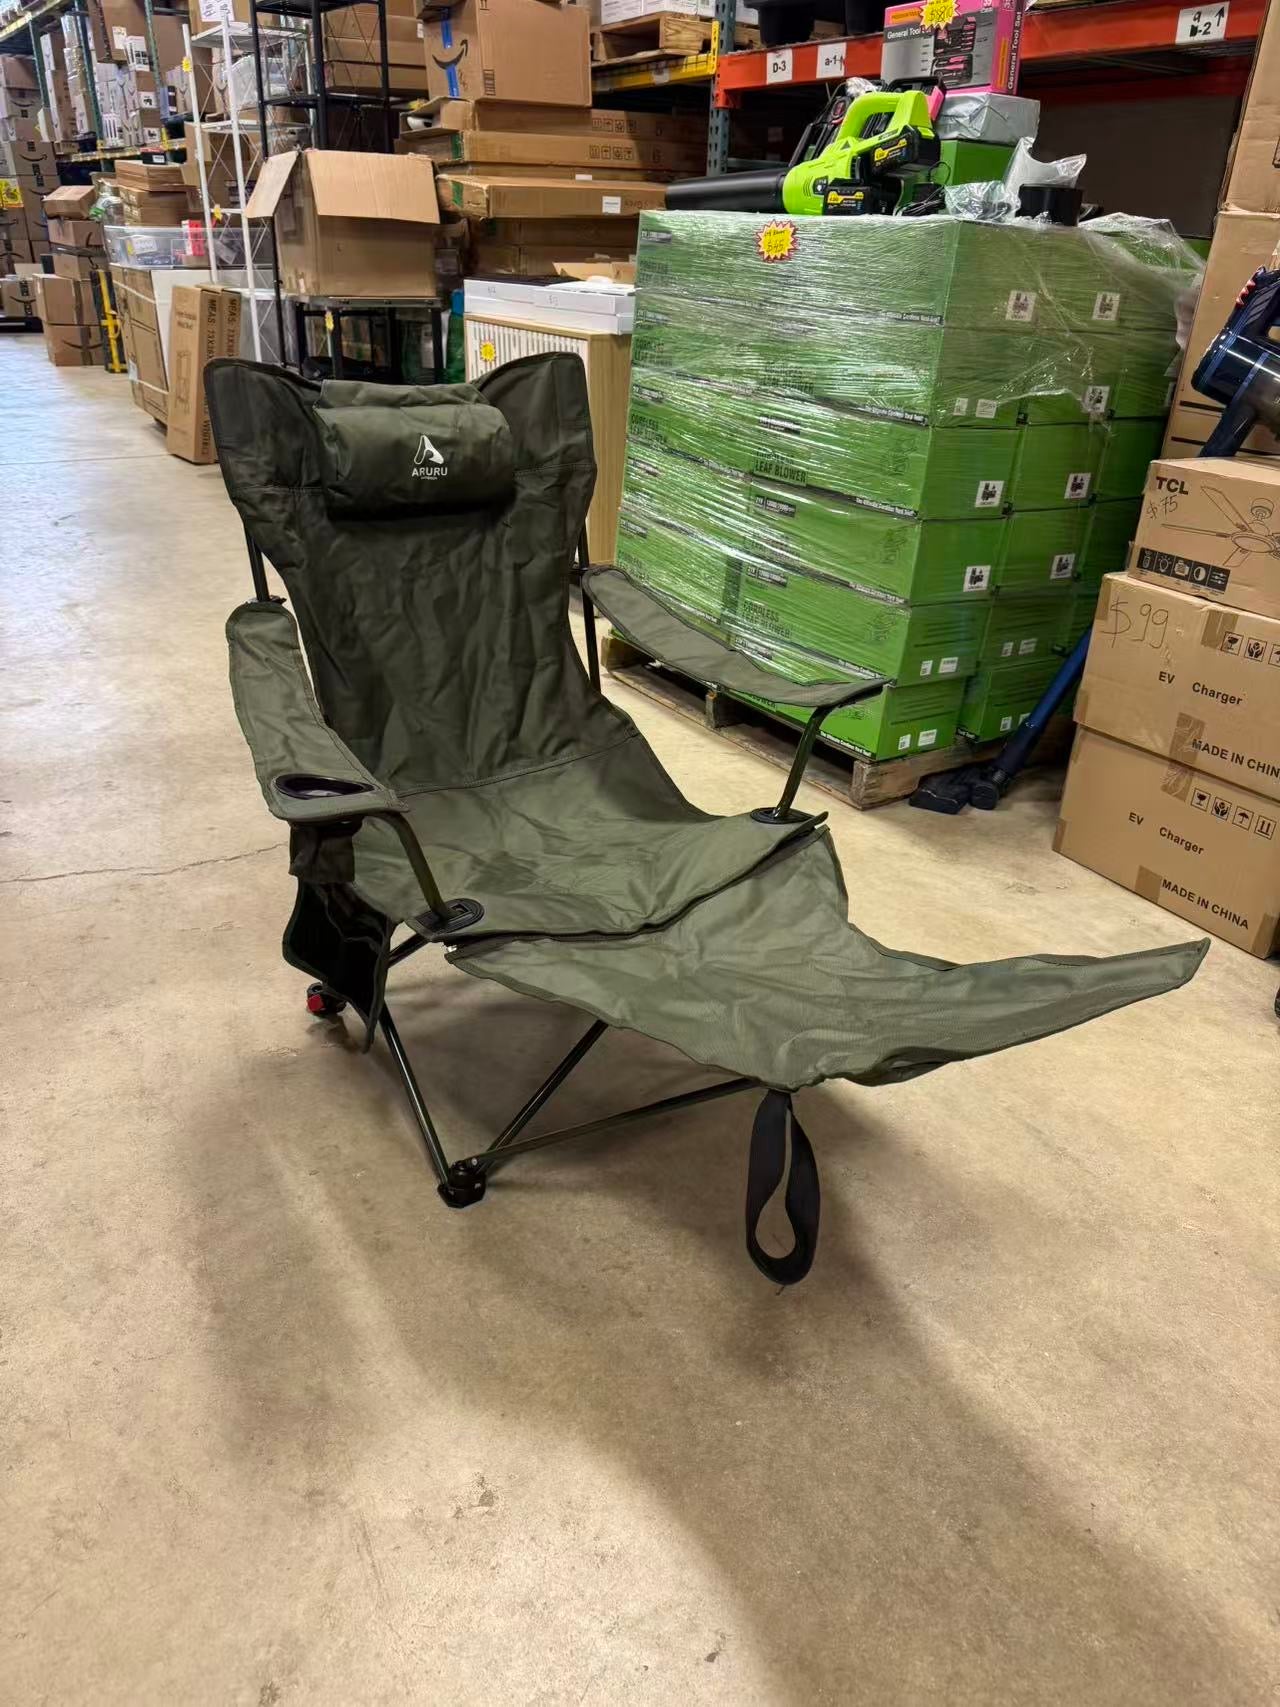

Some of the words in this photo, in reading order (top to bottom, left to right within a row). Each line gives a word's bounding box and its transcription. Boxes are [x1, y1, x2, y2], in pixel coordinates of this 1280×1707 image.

[888, 28, 909, 39] General
[773, 61, 786, 73] D-3
[1008, 53, 1017, 90] General
[411, 466, 448, 477] ARURU
[754, 459, 773, 474] LEAF
[774, 464, 806, 483] BLOWER
[1156, 476, 1189, 495] TCL
[1100, 595, 1169, 649] $99
[1158, 671, 1176, 684] EV
[1192, 682, 1243, 705] Charger
[1192, 738, 1229, 761] MADE
[1230, 752, 1245, 766] IN
[1128, 812, 1145, 825] EV
[1159, 827, 1205, 855] Charger
[1162, 879, 1196, 902] MADE
[1196, 896, 1209, 909] IN
[1211, 904, 1249, 930] CHINA
